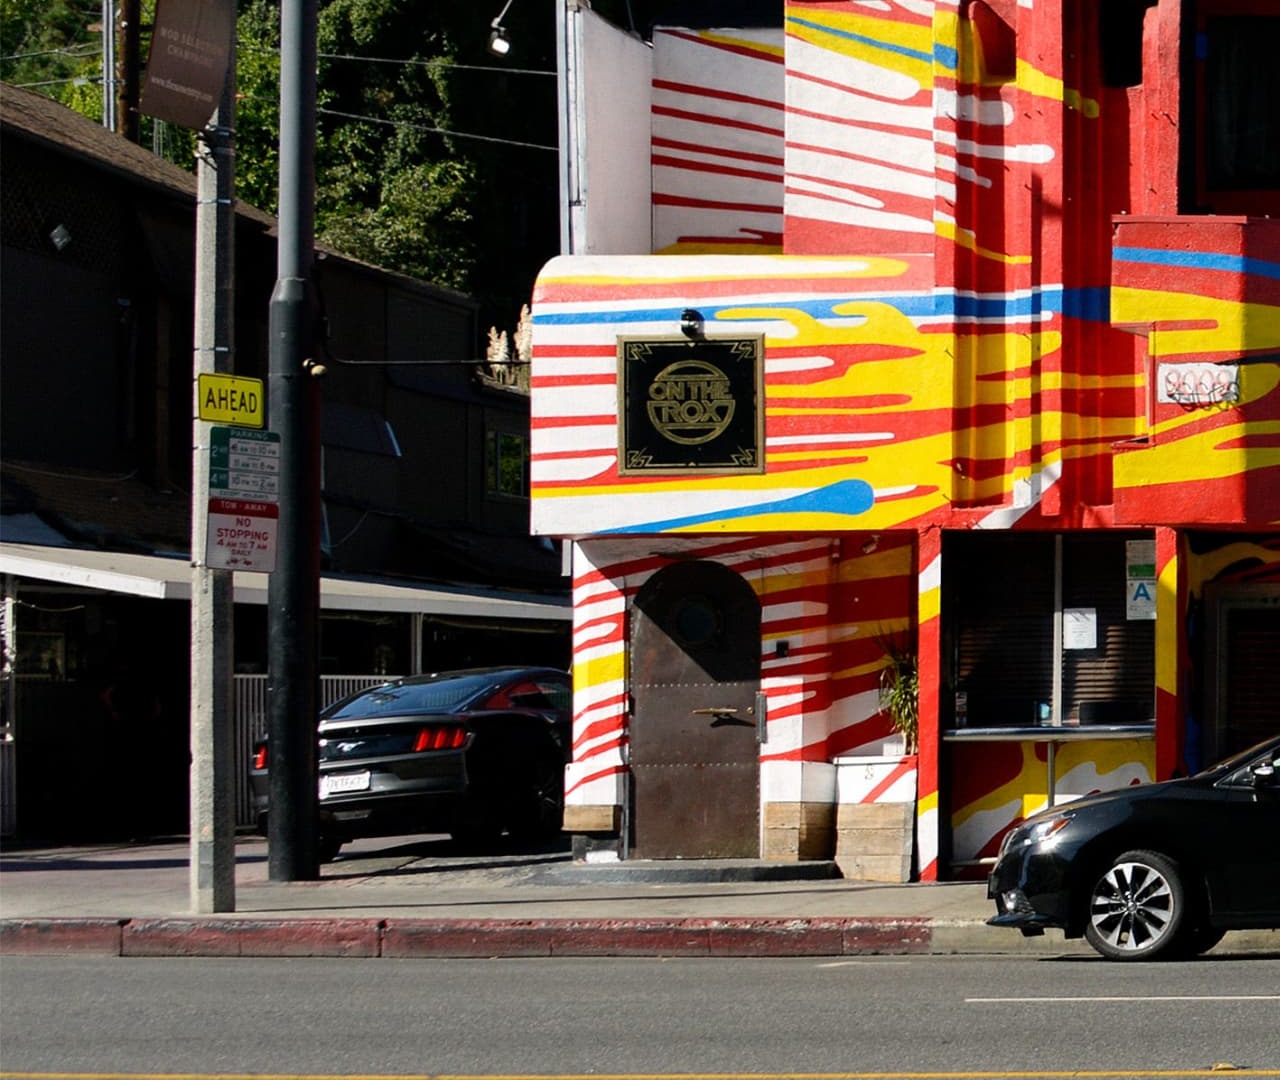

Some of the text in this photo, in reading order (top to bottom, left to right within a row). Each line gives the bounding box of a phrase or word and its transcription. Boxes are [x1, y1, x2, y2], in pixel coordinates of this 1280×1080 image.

[648, 380, 733, 401] ON THE
[205, 387, 258, 414] AHEAD
[660, 399, 722, 424] ROX
[230, 428, 269, 441] PARKING
[235, 517, 252, 527] NO
[216, 527, 269, 541] STOPPING
[248, 540, 256, 550] 7
[1132, 582, 1152, 601] A
